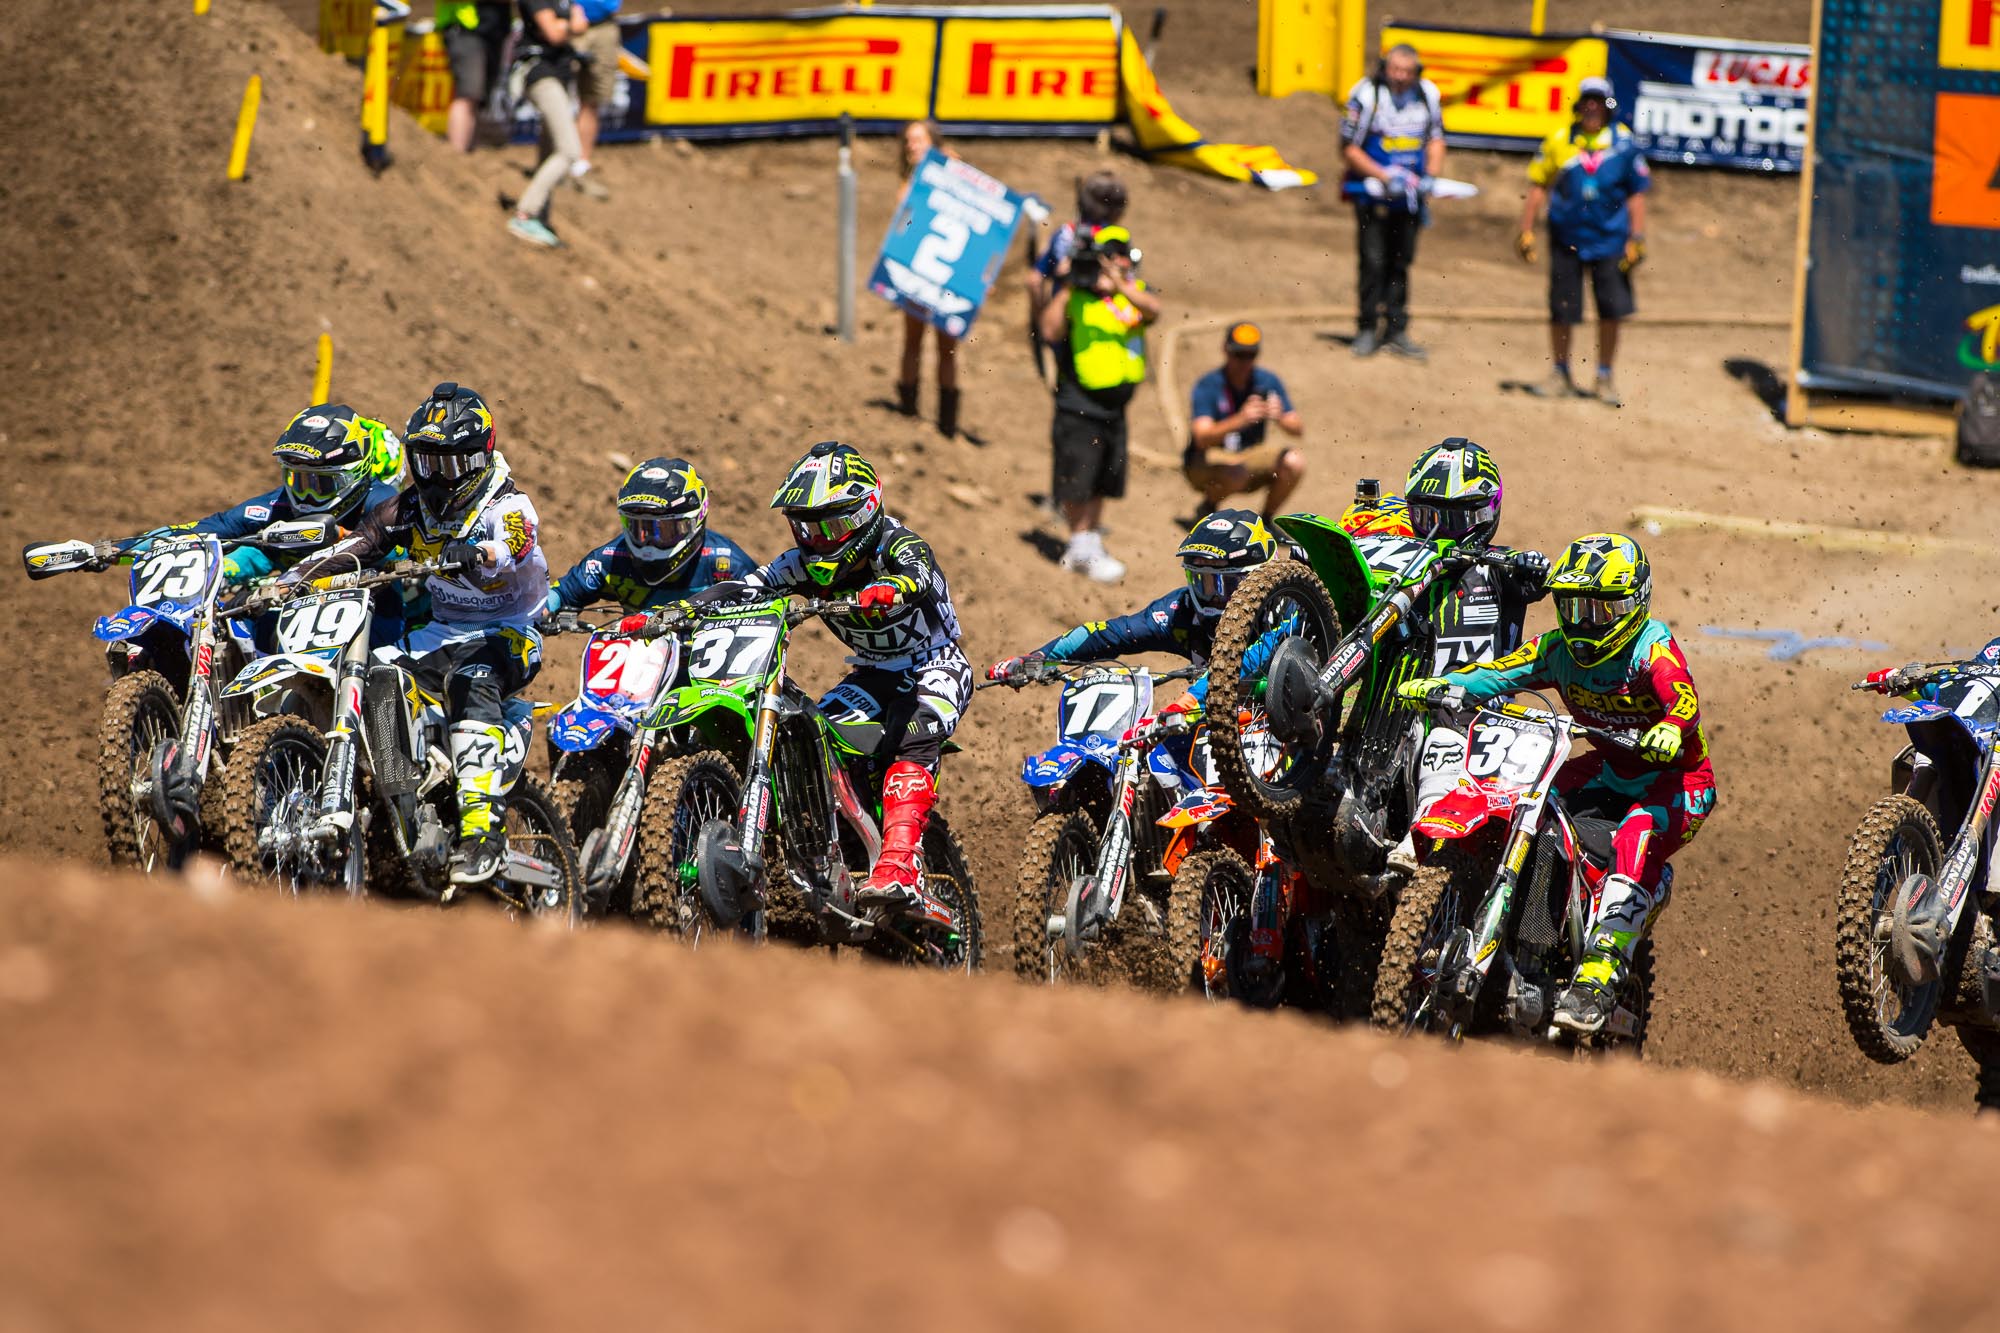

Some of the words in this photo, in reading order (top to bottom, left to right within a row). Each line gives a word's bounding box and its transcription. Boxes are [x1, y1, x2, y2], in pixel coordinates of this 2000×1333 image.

[669, 38, 899, 99] PIRELLI
[911, 212, 971, 286] 2
[151, 543, 177, 557] LUCAS
[177, 542, 191, 552] OIL
[136, 550, 213, 607] 23
[302, 594, 326, 606] LUC
[327, 592, 341, 600] OIL
[446, 592, 514, 606] Husqvarna
[283, 600, 363, 654] 49
[714, 619, 741, 629] LUCAS
[741, 617, 757, 626] OIL
[688, 625, 778, 679] 37
[1320, 641, 1357, 684] DUNLOP
[1341, 648, 1365, 679] BRAKING
[1084, 675, 1109, 686] LUCAS
[1567, 683, 1662, 713] GEICO
[1064, 683, 1145, 736] 17
[1497, 718, 1527, 730] LUCAS
[1527, 724, 1542, 734] OIL
[1582, 708, 1652, 725] HONDA
[344, 743, 357, 802] DUNLOP
[1468, 725, 1552, 785] 39
[743, 781, 761, 852] DUNLOP
[757, 786, 769, 832] BRAKING
[1420, 816, 1466, 832] GEICO
[1420, 822, 1457, 835] HONDA
[1941, 839, 1972, 899] DUNLOP
